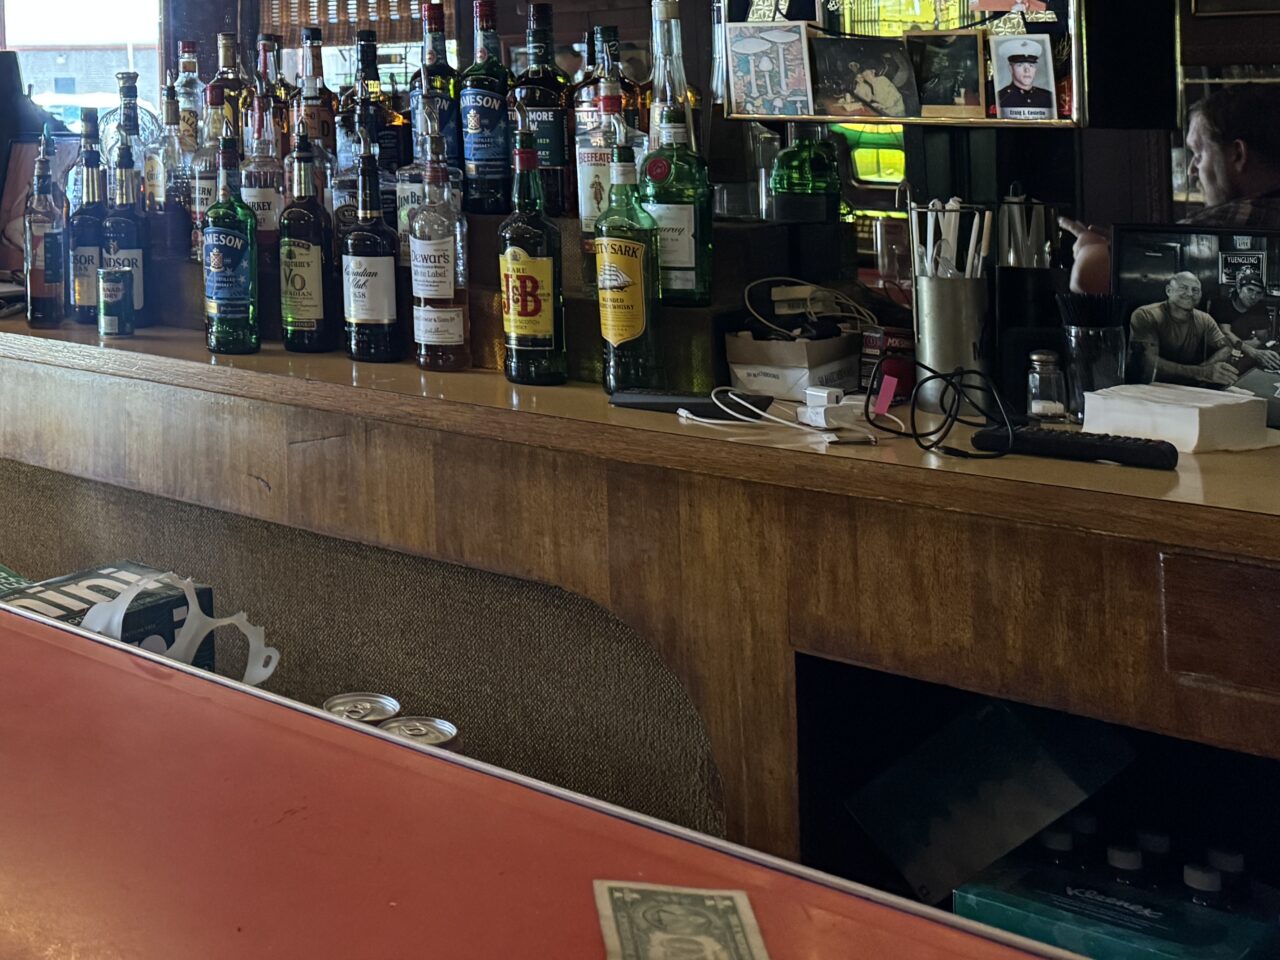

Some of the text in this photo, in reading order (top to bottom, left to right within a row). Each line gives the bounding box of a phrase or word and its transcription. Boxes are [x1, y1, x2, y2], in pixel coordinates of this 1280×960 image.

[410, 250, 450, 264] Dewar's
[610, 243, 640, 258] SARK
[1227, 256, 1258, 264] YUENGLING
[502, 272, 542, 318] J&B
